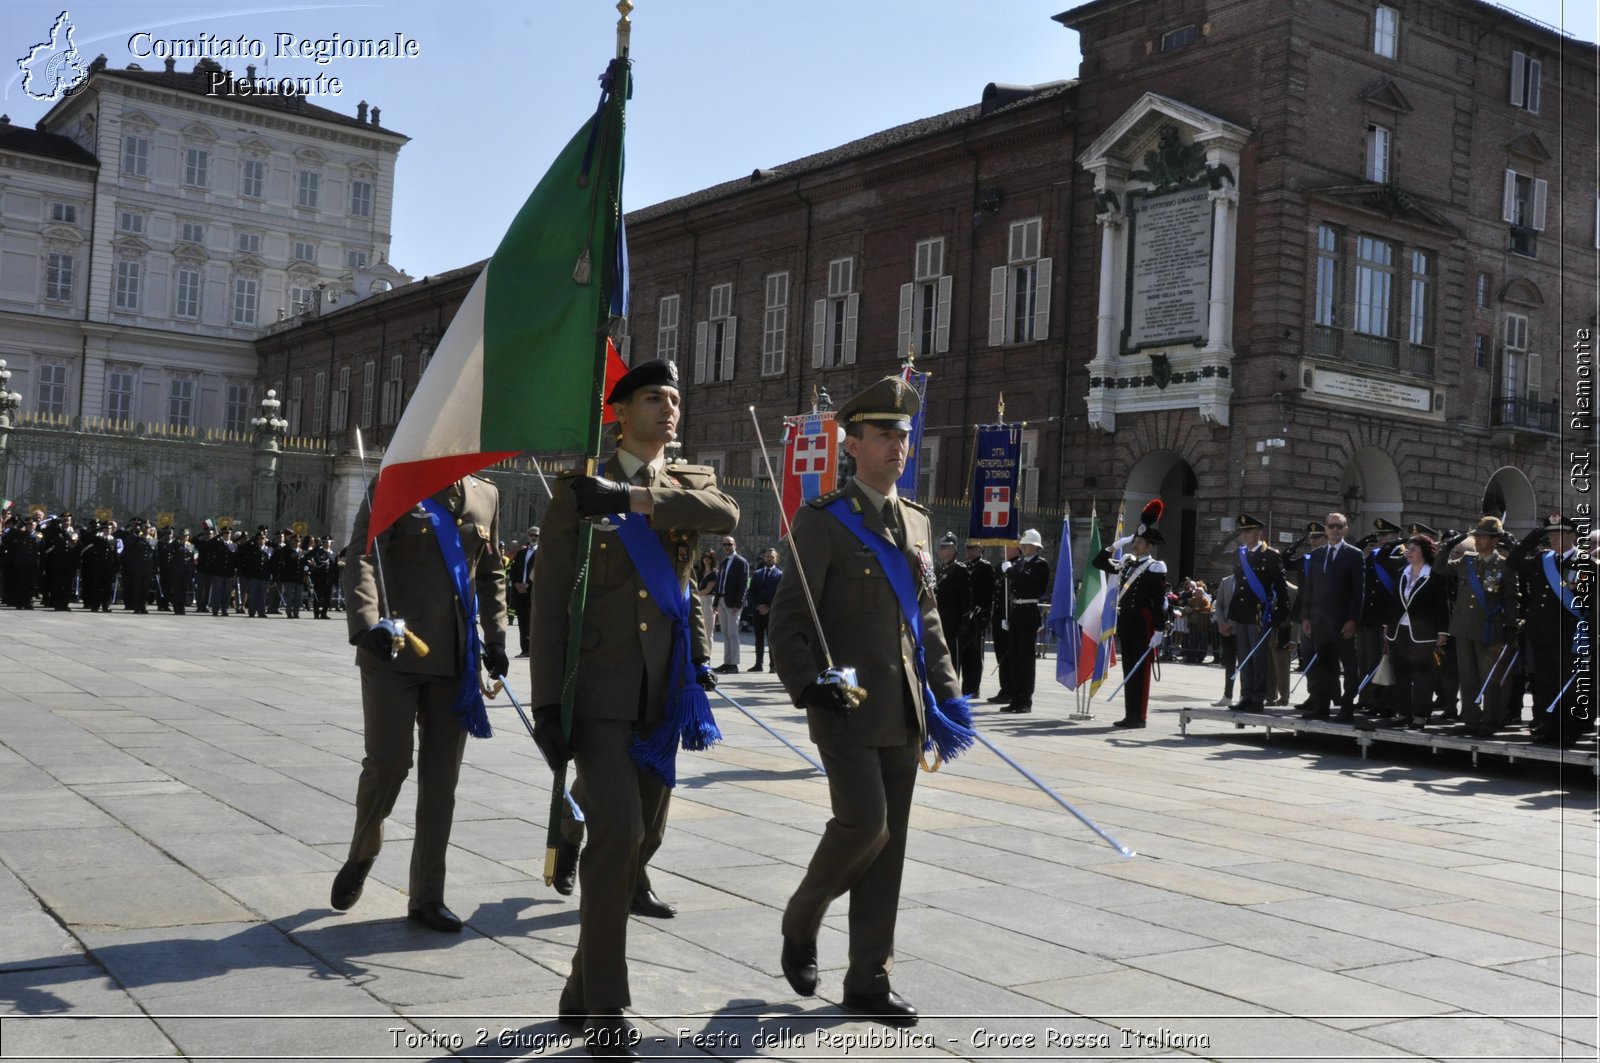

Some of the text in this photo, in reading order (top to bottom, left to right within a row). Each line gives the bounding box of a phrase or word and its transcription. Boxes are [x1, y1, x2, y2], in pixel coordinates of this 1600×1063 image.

[1149, 199, 1177, 210] VITTORIO
[985, 470, 1011, 479] DI TORINO
